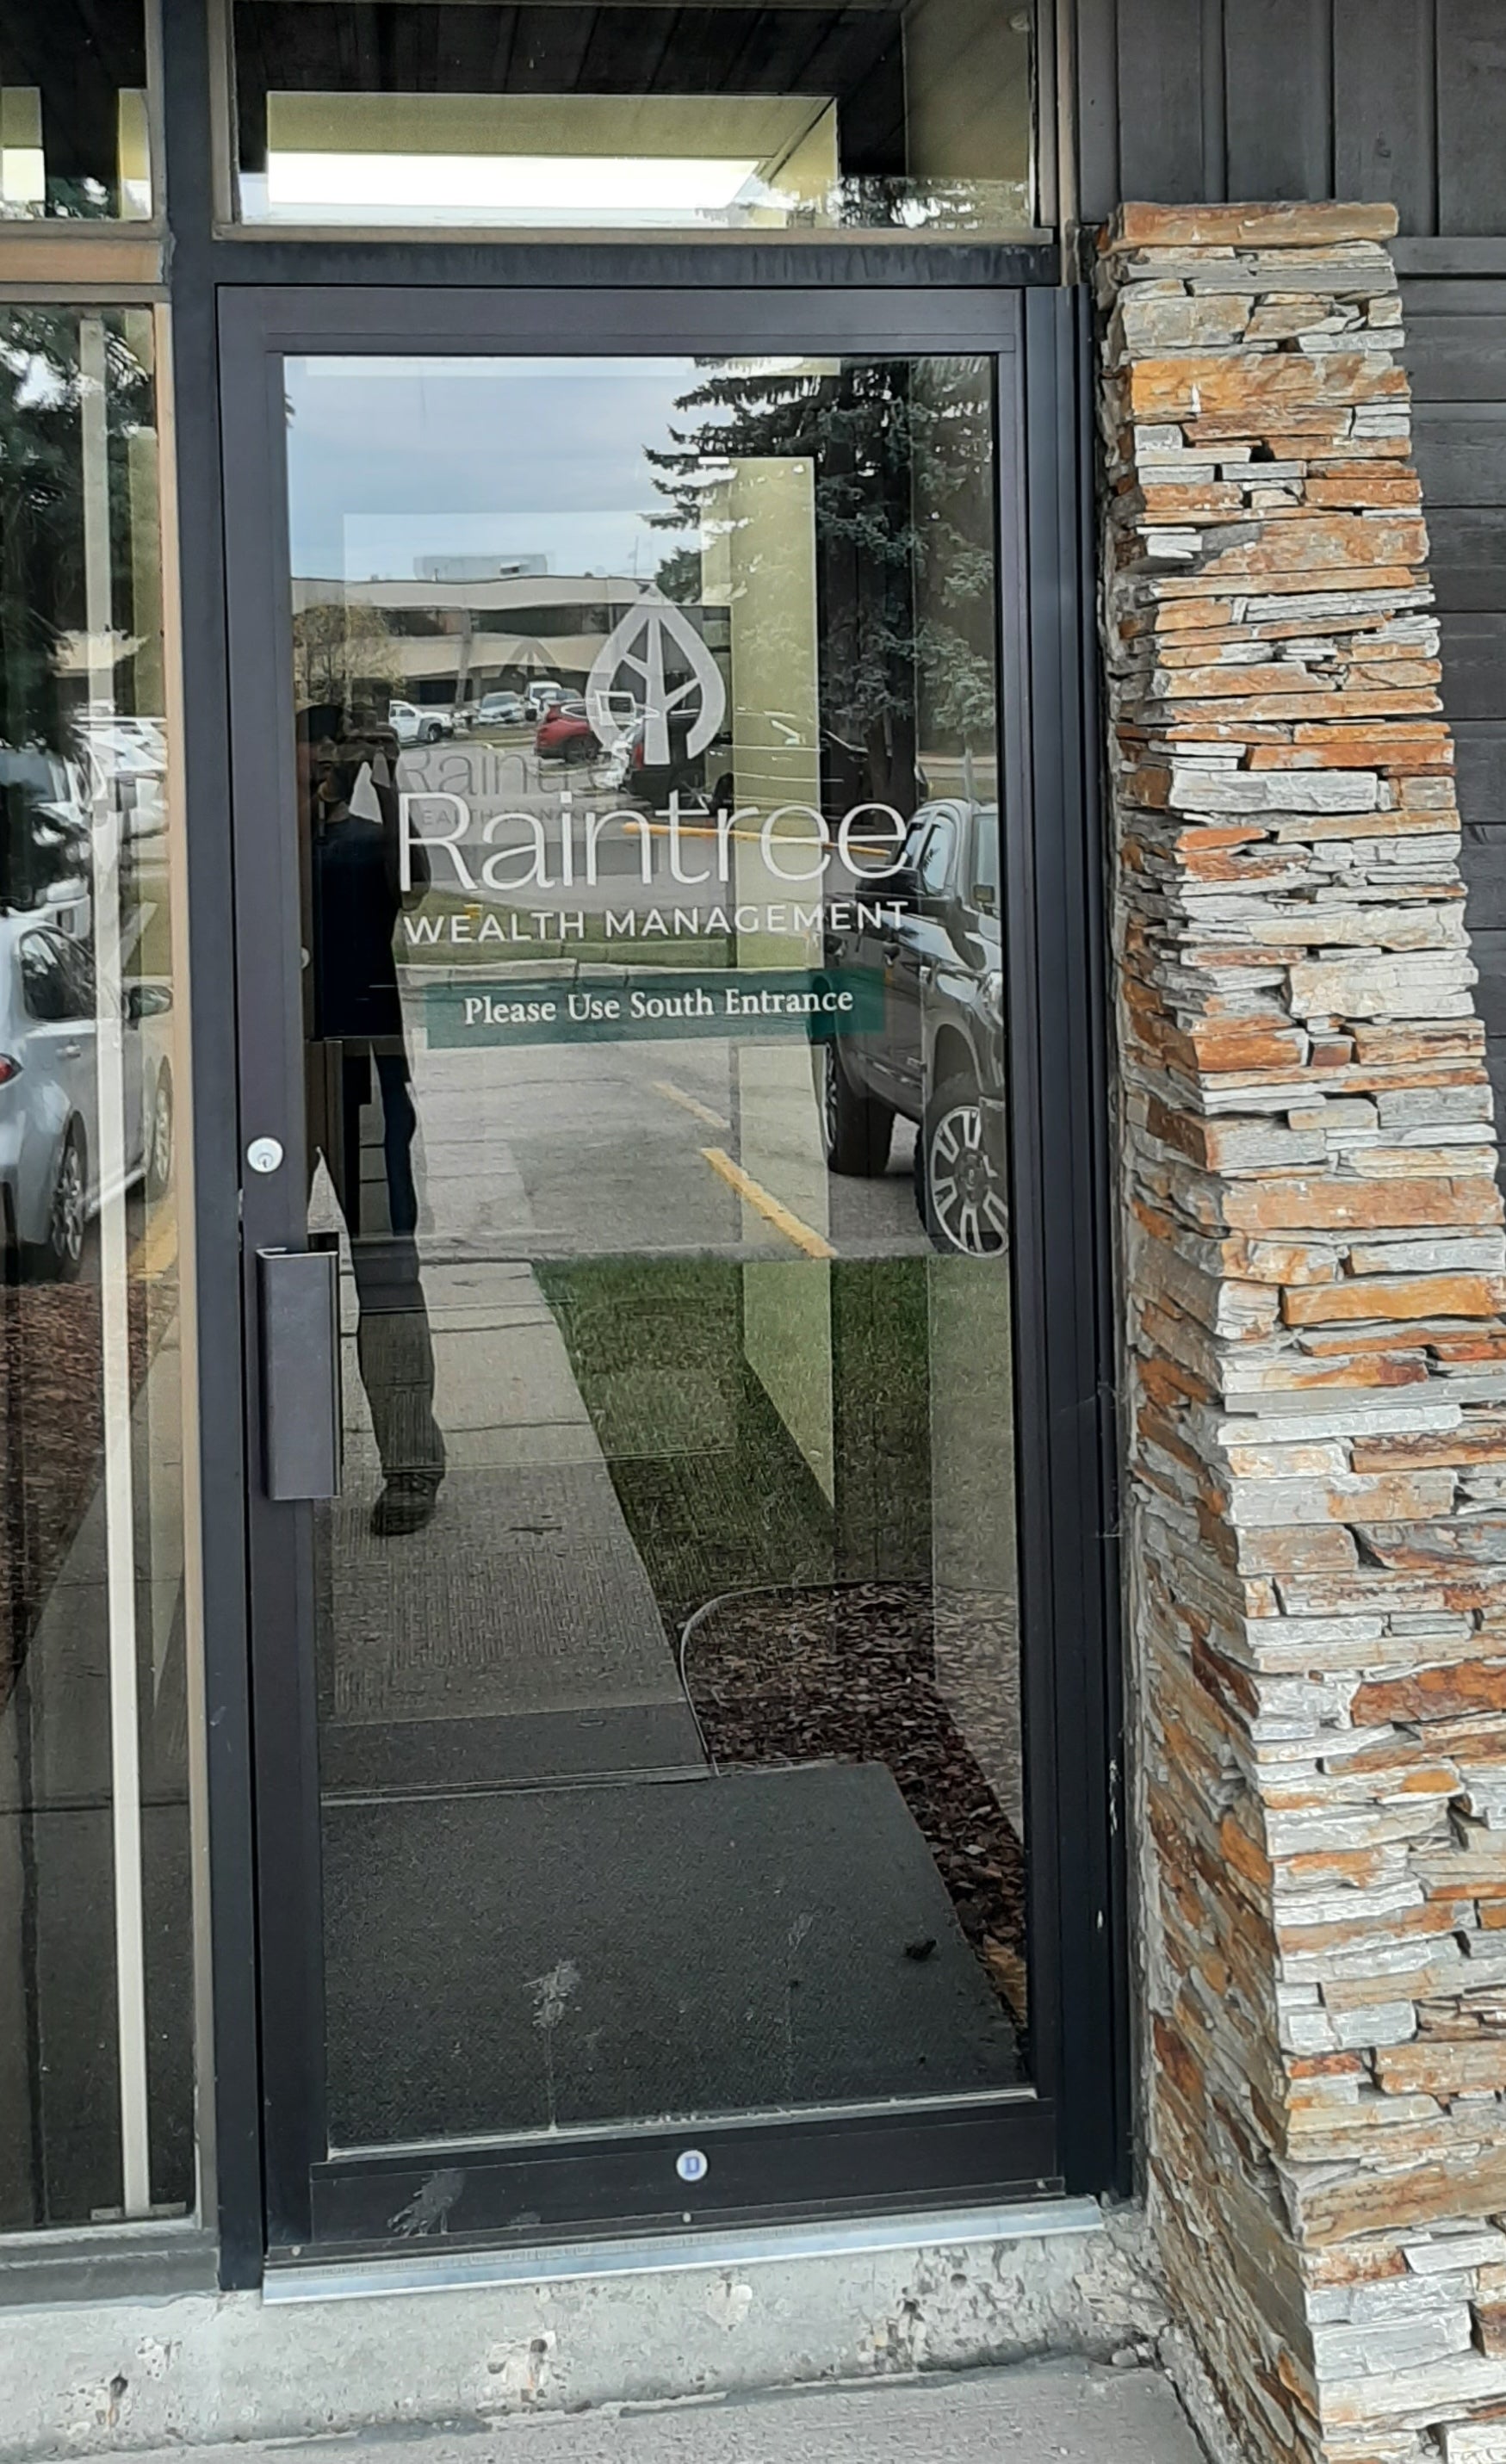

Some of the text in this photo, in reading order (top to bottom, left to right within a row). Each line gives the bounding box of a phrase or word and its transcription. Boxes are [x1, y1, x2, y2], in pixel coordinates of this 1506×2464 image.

[399, 789, 908, 892] Raintree
[403, 901, 908, 944] WEALTH MANAGEMENT
[464, 988, 853, 1025] Please Use South Entrance
